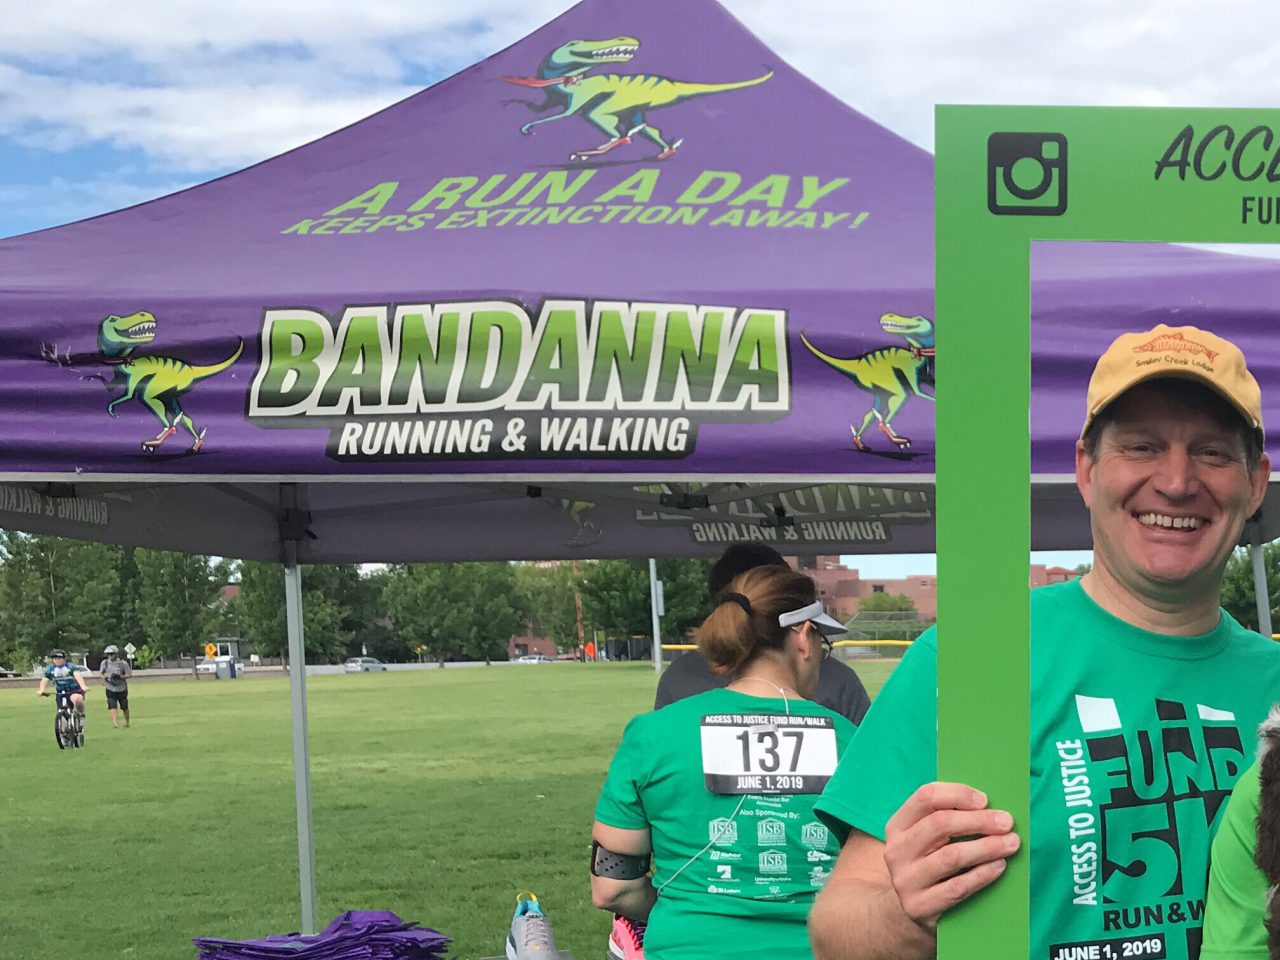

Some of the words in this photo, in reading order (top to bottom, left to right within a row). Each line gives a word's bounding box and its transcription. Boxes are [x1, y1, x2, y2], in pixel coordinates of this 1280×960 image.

[322, 181, 399, 216] A
[406, 169, 597, 212] RUN
[593, 169, 661, 203] A
[676, 170, 851, 209] DAY
[280, 213, 435, 234] KEEPS
[434, 205, 708, 229] EXTINCTION
[709, 209, 870, 229] AWAY!
[248, 300, 791, 417] BANDANNA
[337, 418, 493, 455] RUNNING
[501, 419, 527, 452] &
[538, 416, 690, 453] WALKING
[705, 715, 732, 724] ACCESS
[732, 715, 742, 724] TO
[743, 715, 769, 725] JUSTICE
[770, 716, 787, 726] FUND
[736, 730, 804, 773] 137
[737, 775, 762, 790] JUNE
[765, 776, 775, 790] 1,
[776, 776, 804, 789] 2019
[1056, 738, 1093, 808] JUSTICE
[762, 822, 781, 835] ISB
[1068, 812, 1096, 839] TO
[764, 854, 783, 866] ISB
[1070, 841, 1098, 906] ACCESS
[1121, 937, 1162, 956] 2019
